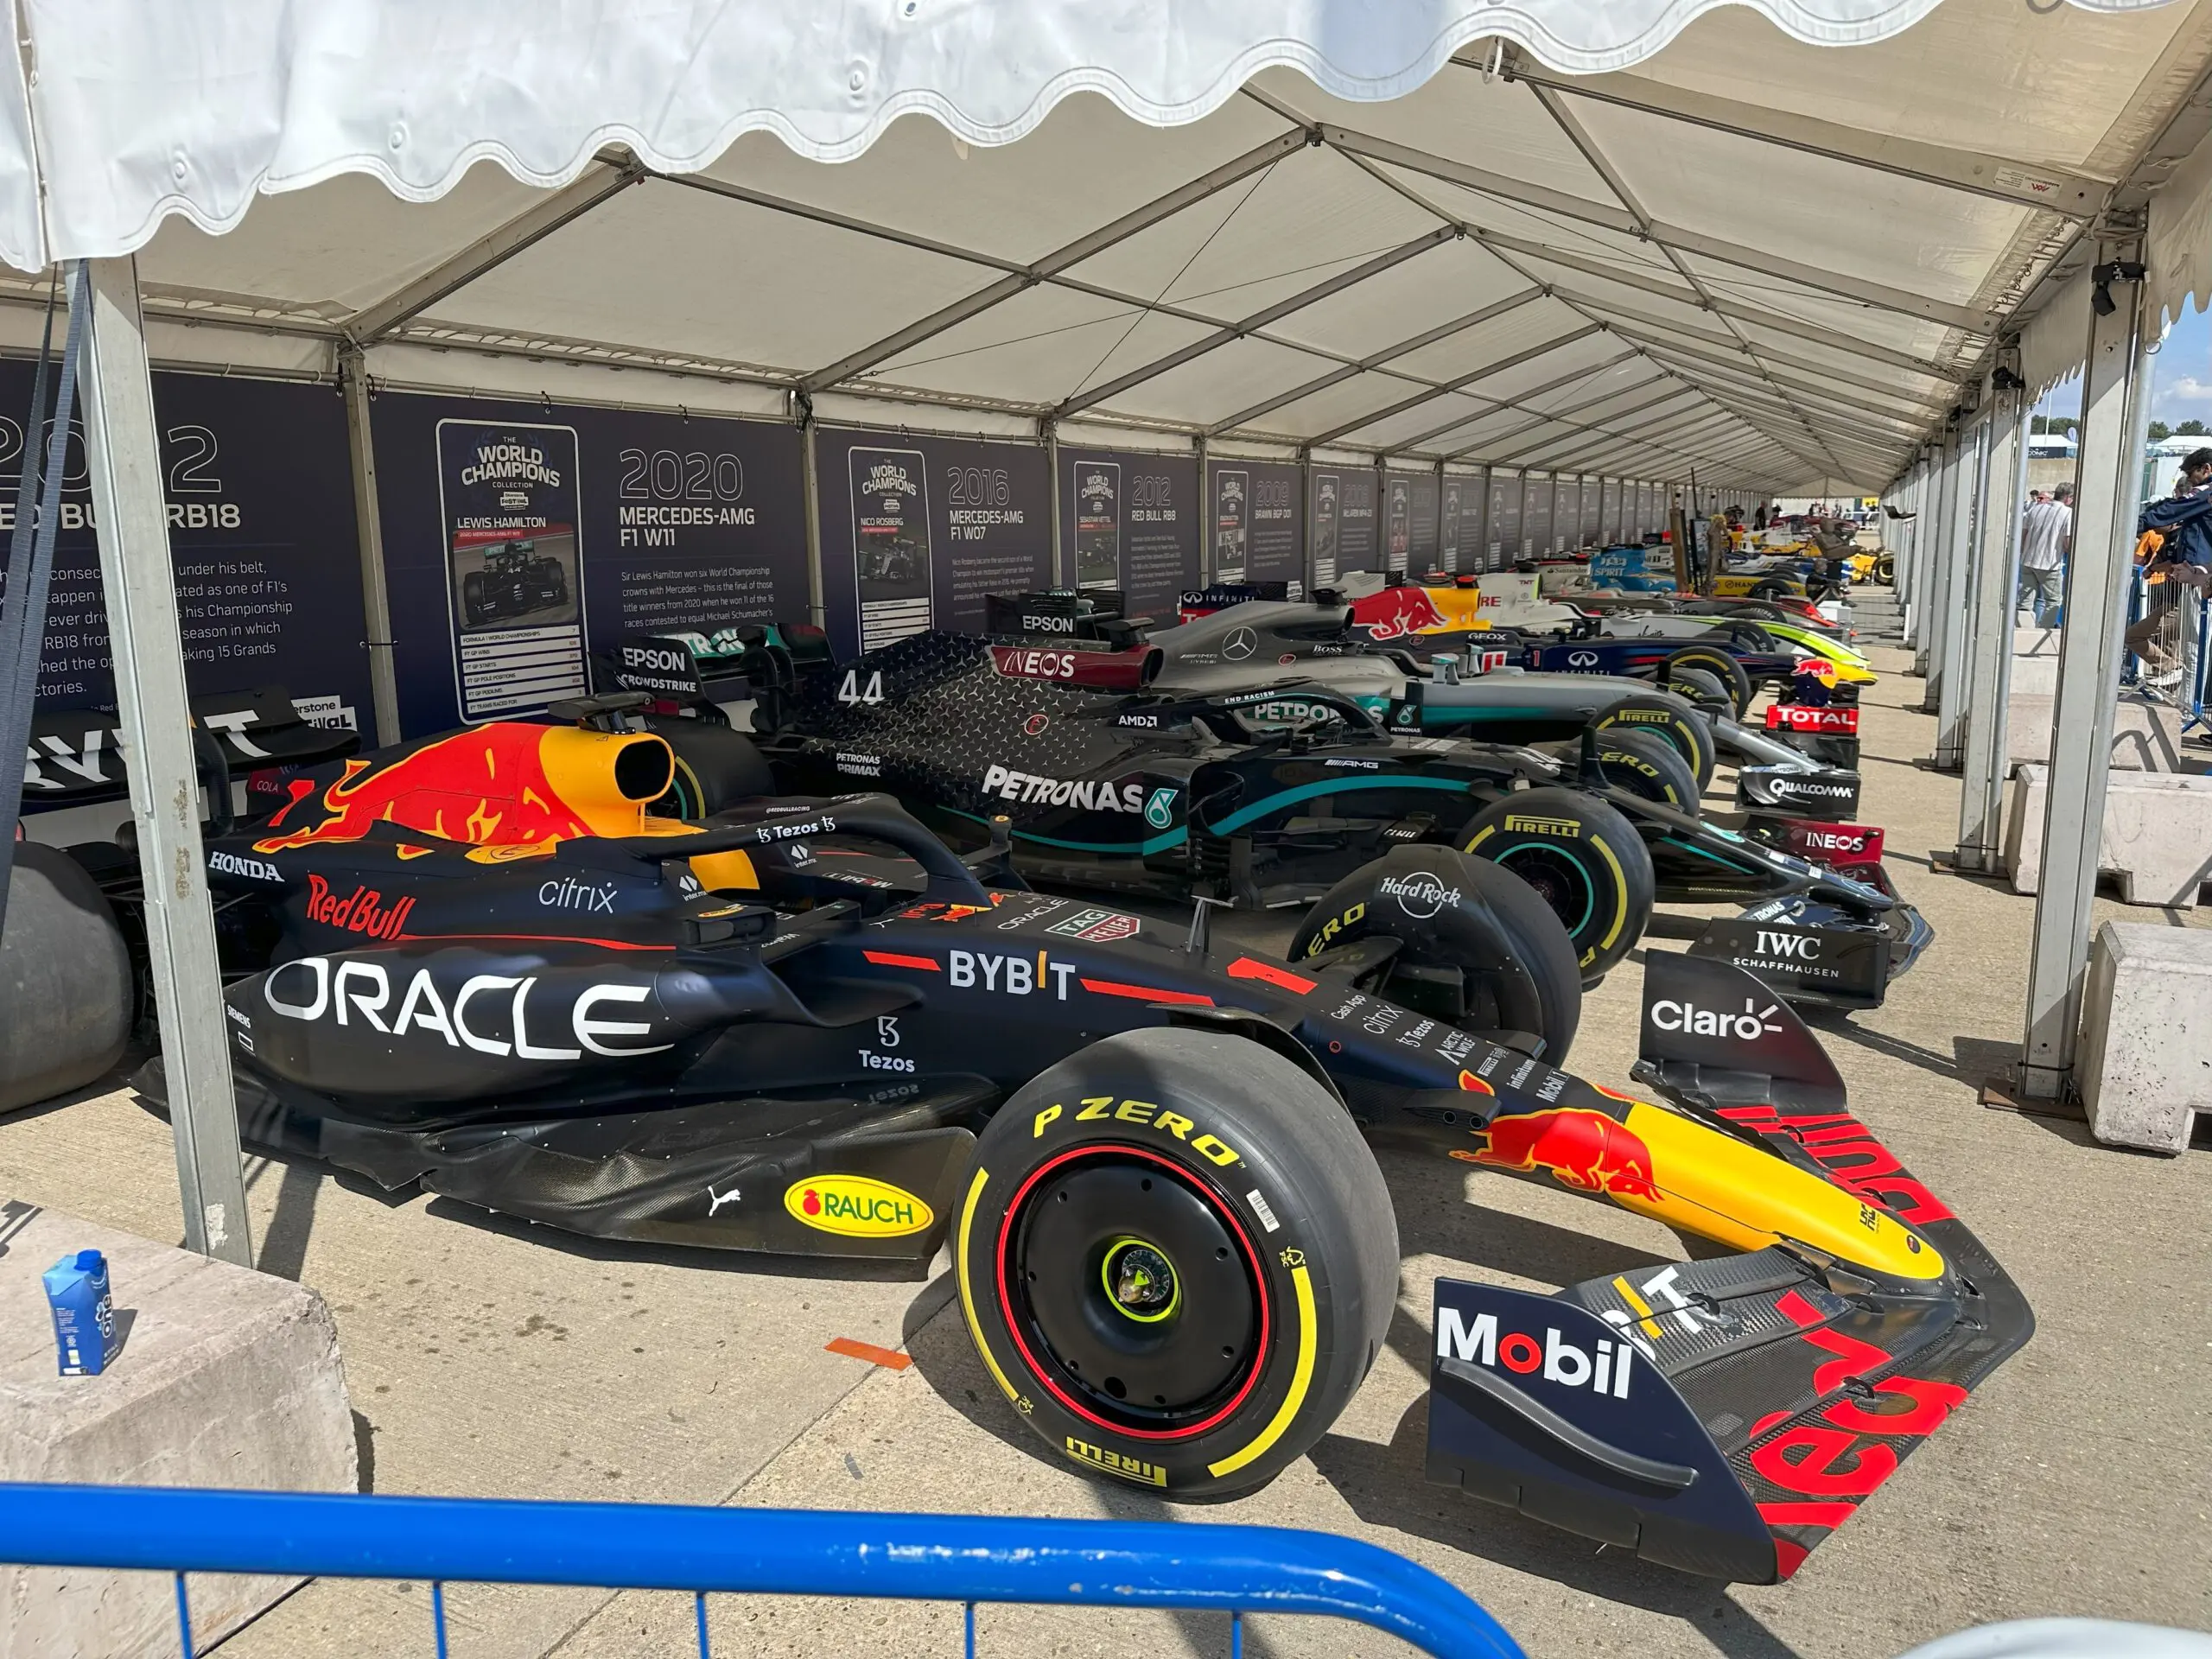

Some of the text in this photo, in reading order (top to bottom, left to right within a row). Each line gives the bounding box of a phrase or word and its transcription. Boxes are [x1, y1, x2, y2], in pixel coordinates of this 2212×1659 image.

[477, 444, 543, 465] WORLD
[461, 461, 561, 487] CHAMPIONS
[620, 448, 743, 501] 2020
[870, 465, 906, 480] WORLD
[1086, 474, 1109, 486] WORLD
[862, 477, 916, 496] CHAMPIONS
[947, 467, 1009, 505] 2016
[1081, 486, 1114, 499] CHAMPIONS
[1132, 475, 1172, 506] 2012
[1255, 480, 1289, 506] 2009
[166, 503, 241, 529] RB18
[457, 517, 546, 529] LEWIS HAMILTON
[619, 506, 755, 525] MERCEDES-AMG
[875, 517, 904, 526] ROSBERG
[950, 510, 1024, 524] MERCEDES-AMG
[1131, 510, 1144, 521] RED
[1146, 510, 1162, 521] BULL
[620, 528, 676, 547] F1 W11
[950, 526, 986, 540] F1 W07
[178, 560, 267, 575] under his belt,
[621, 572, 632, 582] Sir
[632, 570, 652, 581] Lewis
[653, 569, 683, 580] Hamilton
[698, 569, 708, 578] six
[709, 568, 728, 578] World
[728, 566, 770, 579] Championship
[1594, 568, 1624, 576] SPIRIT
[207, 587, 221, 596] as
[225, 584, 248, 595] one
[251, 582, 264, 594] of
[622, 580, 773, 597] crowns with Mercedes this is the final of those
[186, 601, 293, 619] his Championship
[624, 602, 638, 613] title
[639, 601, 665, 612] winners
[667, 600, 683, 609] from
[683, 599, 701, 608] 2020
[702, 597, 719, 607] when
[720, 596, 728, 606] he
[728, 597, 742, 606] won
[749, 595, 756, 604] of
[757, 594, 766, 603] the
[625, 607, 772, 628] races contested to equal Michael Schumacher's
[1022, 614, 1074, 633] EPSON
[45, 621, 281, 650] RB18 season in which
[1468, 632, 1507, 641] GEOX
[72, 655, 95, 671] the
[218, 645, 230, 658] 15
[233, 642, 276, 656] Grands
[622, 647, 686, 671] EPSON
[1313, 645, 1343, 654] BOSS
[1002, 651, 1076, 678] INEOS
[620, 674, 696, 693] CROWDSTRIKE
[838, 670, 884, 707] 44
[1224, 690, 1275, 704] END RACISM
[1118, 715, 1147, 727] AMD
[1618, 709, 1671, 724] PIRELLI
[1777, 707, 1856, 726] TOTAL
[836, 753, 881, 765] PETRONAS
[836, 763, 881, 777] PRIMAX
[982, 765, 1143, 814] PETRONAS
[1770, 778, 1854, 798] QUALCOMM
[766, 805, 810, 814] @REDBULLRACING
[772, 822, 819, 839] Tezos
[1504, 814, 1581, 838] PIRELLI
[1805, 832, 1864, 852] INEOS
[209, 851, 285, 882] HONDA
[539, 876, 618, 914] citrix
[1380, 876, 1461, 907] Hard Rock
[307, 874, 416, 940] Red Bull
[997, 899, 1071, 930] ORACLE
[1057, 912, 1107, 932] TAG
[1085, 916, 1131, 940] HEUER
[1754, 930, 1821, 961] IWC
[950, 950, 1076, 1001] BYBIT
[1732, 957, 1839, 979] SCHAFFHAUSEN
[264, 957, 675, 1060] ORACLE
[1331, 995, 1367, 1020] Cash App
[1363, 1004, 1403, 1034] citrix
[1651, 999, 1763, 1040] Claro
[1404, 1020, 1435, 1040] Tezos
[1440, 1031, 1465, 1051] ARCTIC
[1456, 1037, 1476, 1055] WOLF
[858, 1049, 915, 1072] Tezos
[1477, 1056, 1499, 1077] PIRELLI
[1506, 1058, 1537, 1090] infinitum
[1535, 1074, 1566, 1103] Mobil
[1033, 1096, 1241, 1166] P ZERO
[824, 1192, 914, 1224] RAUCH
[1437, 1307, 1633, 1399] Mobil
[1065, 1436, 1167, 1488] PIRELLI
